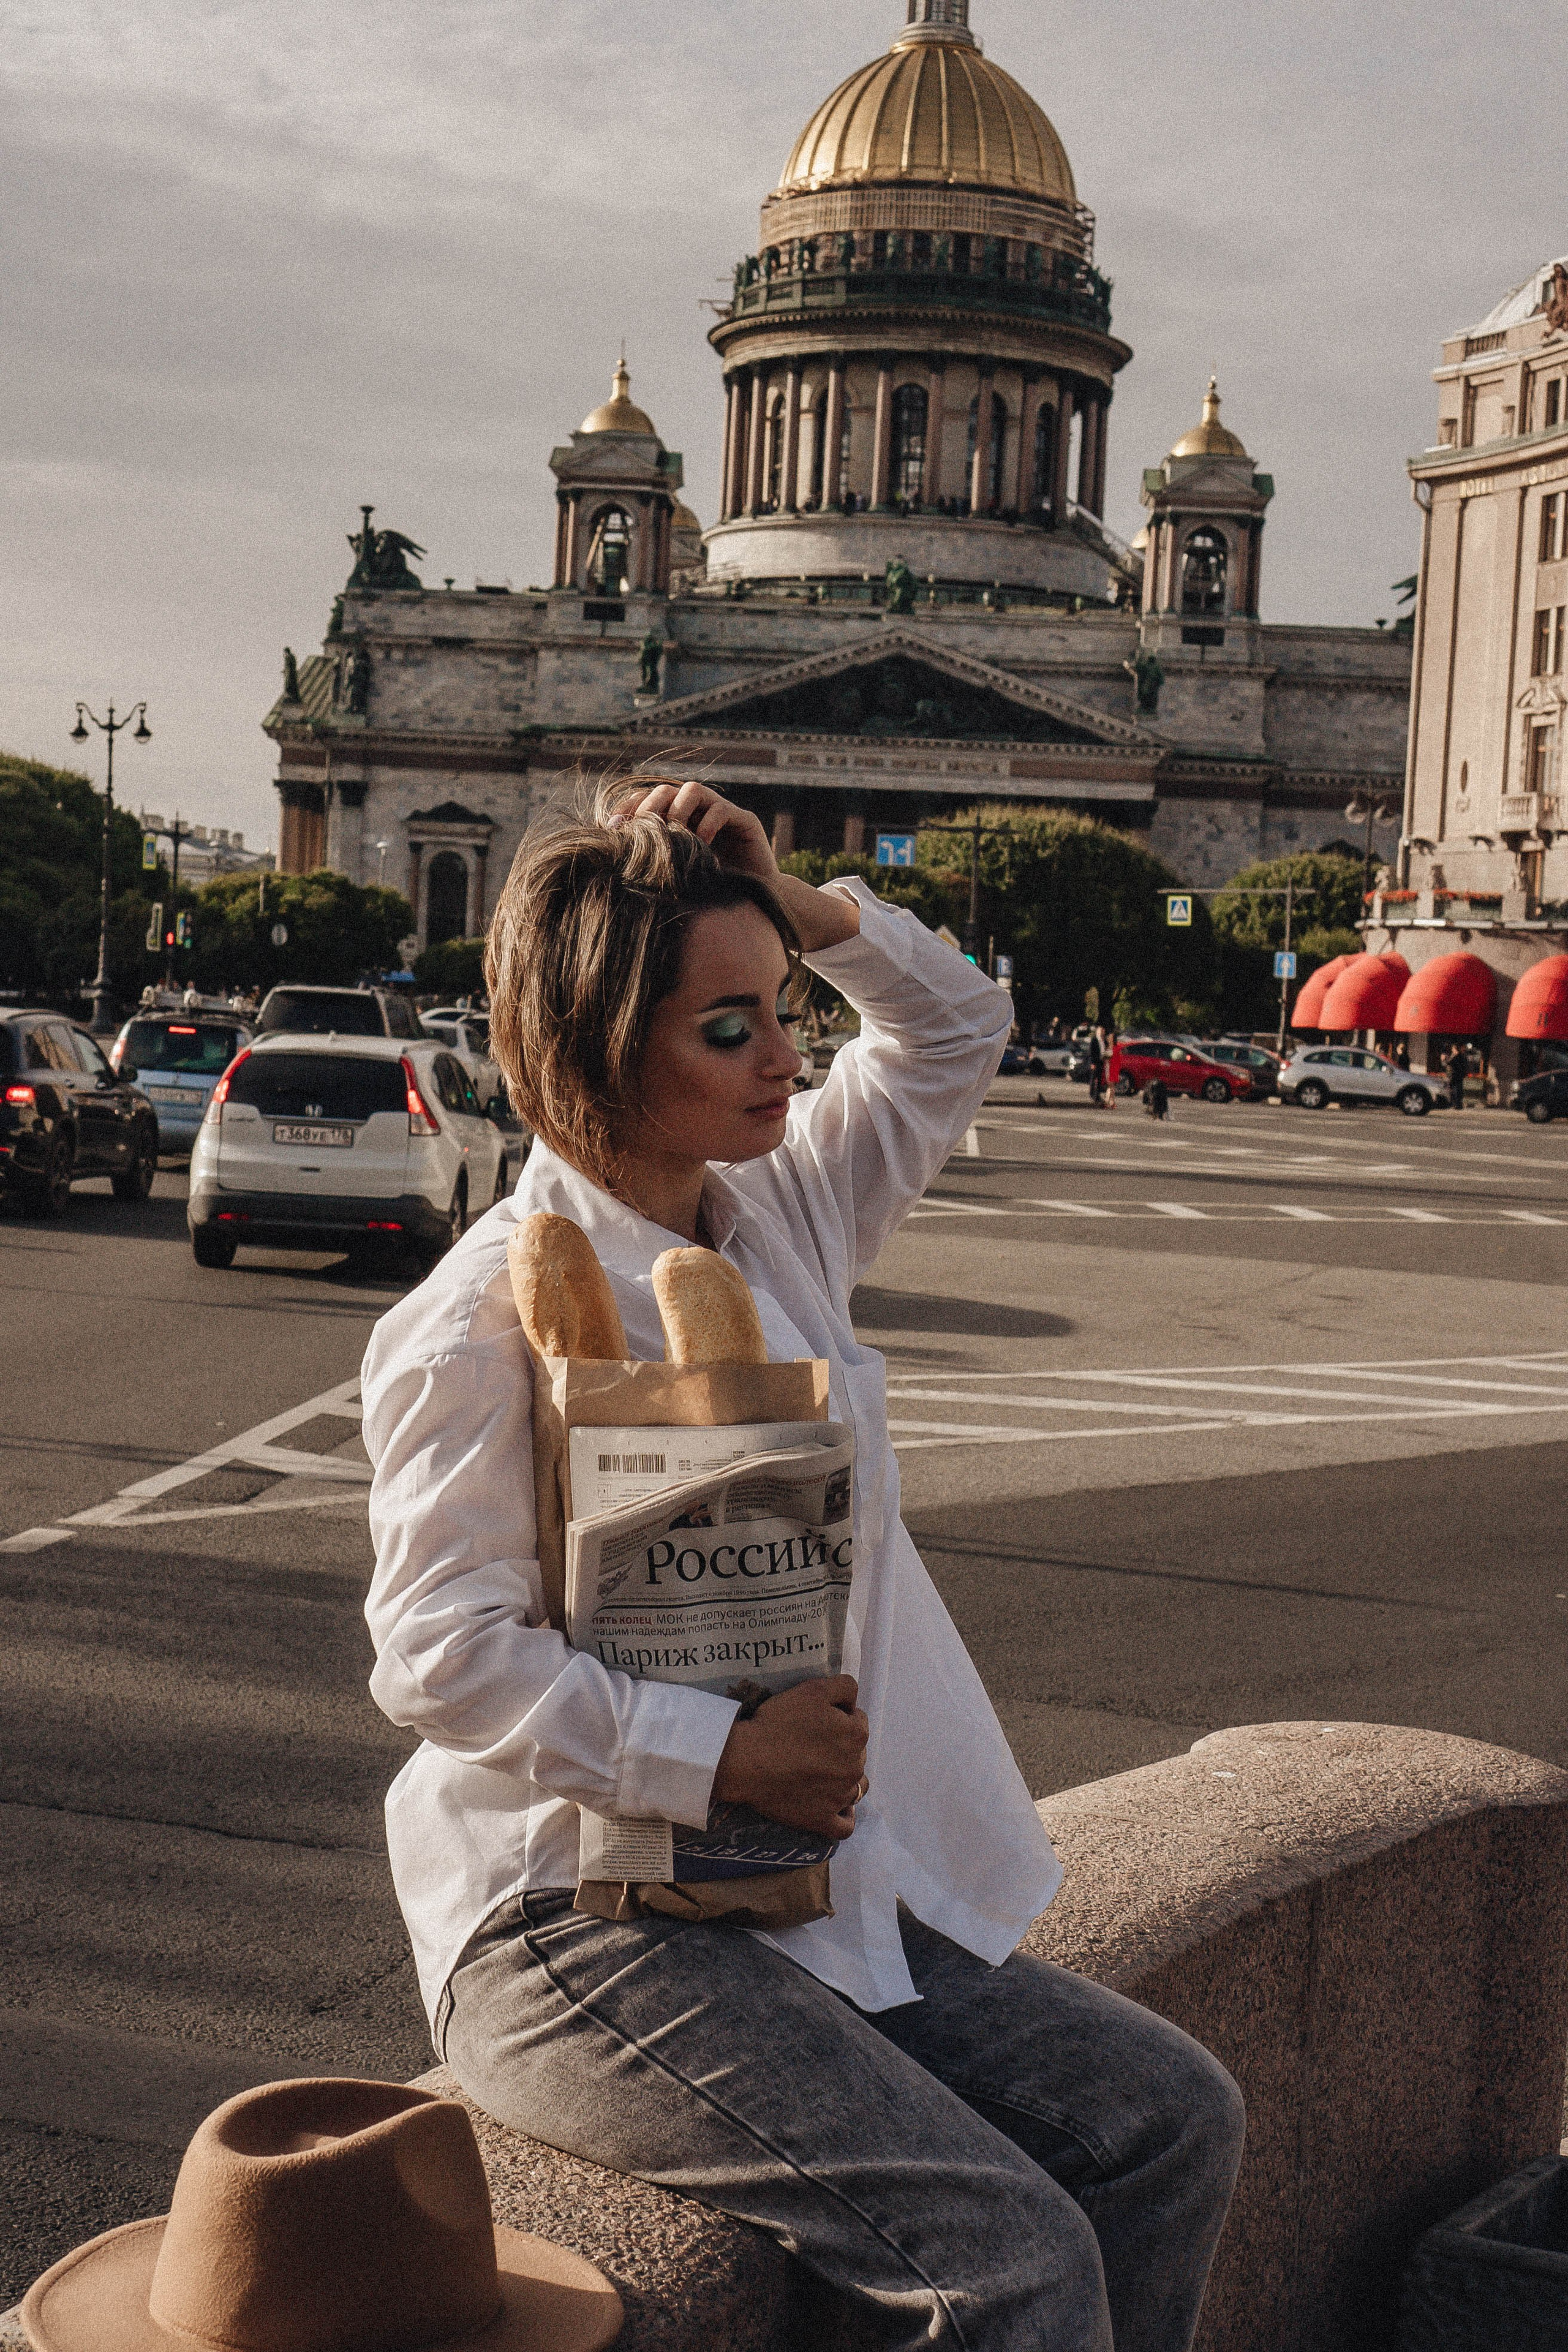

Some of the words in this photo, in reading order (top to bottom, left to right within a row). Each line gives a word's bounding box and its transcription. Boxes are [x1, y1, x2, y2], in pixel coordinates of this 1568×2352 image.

[657, 1613, 684, 1624] МОК
[687, 1613, 698, 1623] не
[700, 1609, 756, 1622] допускает
[760, 1603, 802, 1618] россиян
[805, 1599, 816, 1609] на
[593, 1627, 628, 1636] нашим
[631, 1627, 685, 1637] надеждам
[688, 1621, 730, 1634] попасть
[597, 1640, 700, 1674] Париж
[796, 1852, 819, 1861] 26
